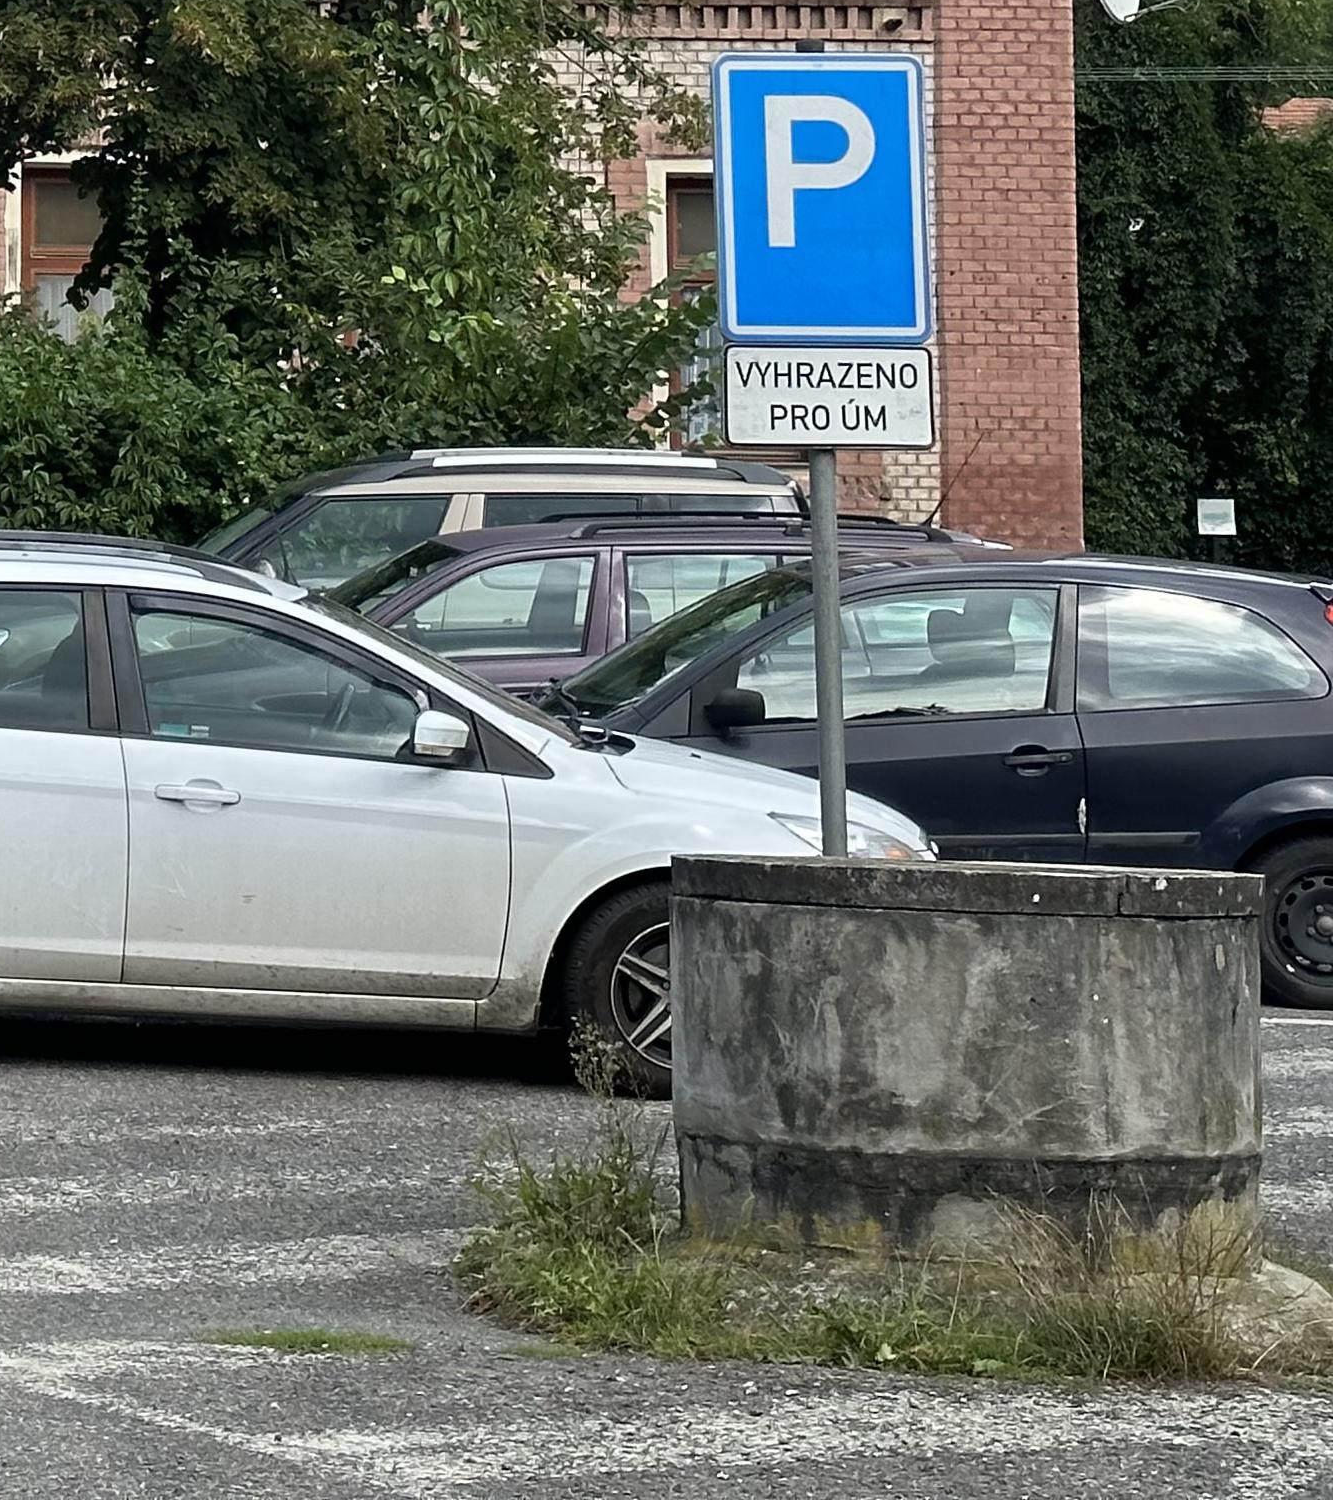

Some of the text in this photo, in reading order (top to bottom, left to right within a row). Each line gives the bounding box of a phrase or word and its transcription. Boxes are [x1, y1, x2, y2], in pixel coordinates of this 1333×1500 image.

[764, 95, 876, 248] P
[735, 361, 918, 390] VYHRAZENO
[770, 398, 887, 431] PRO ÚM
